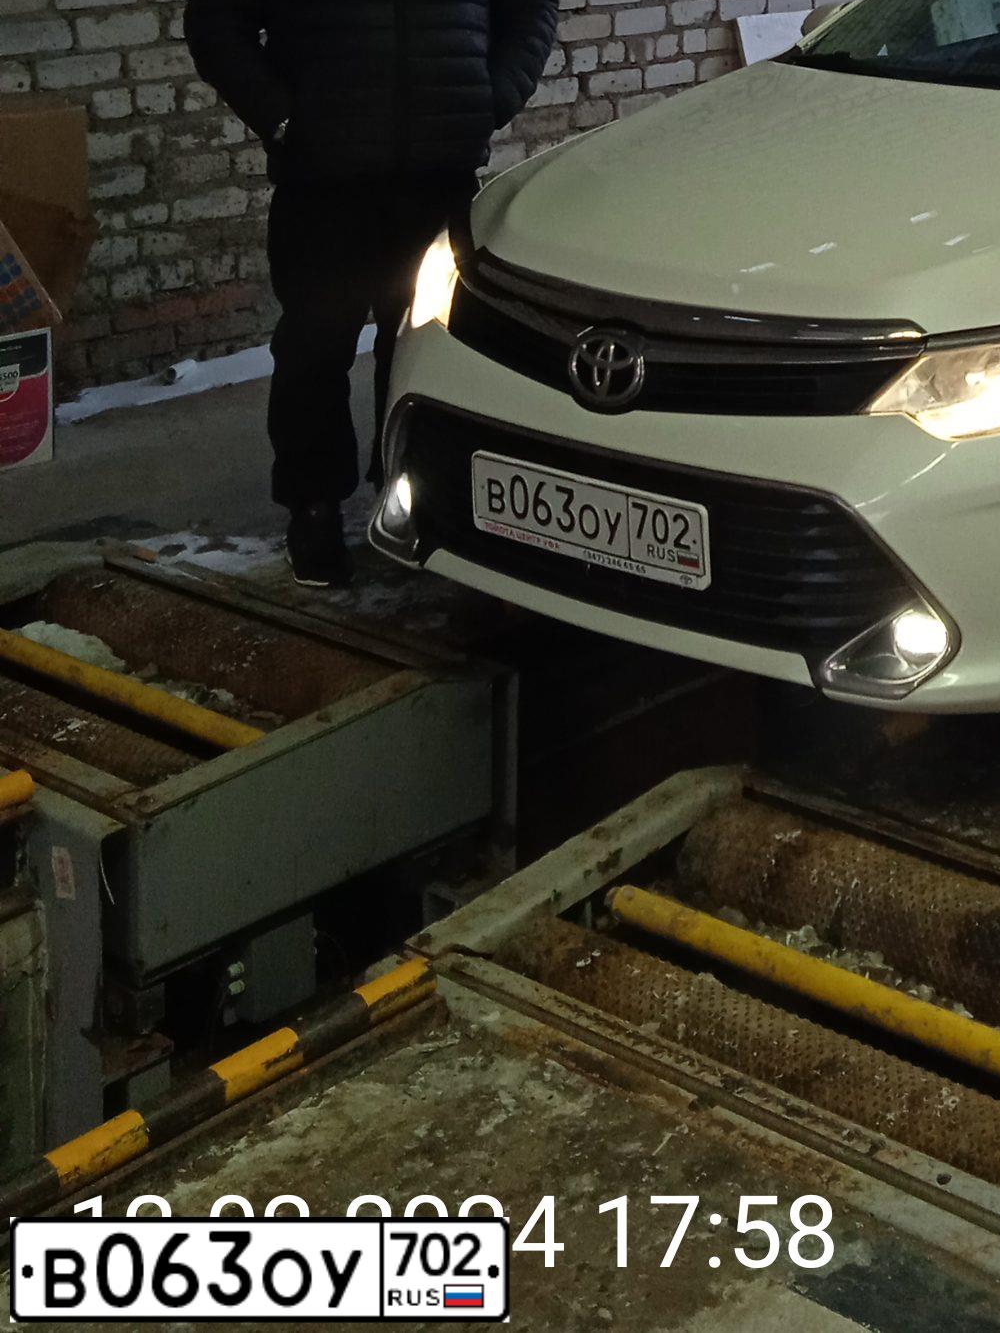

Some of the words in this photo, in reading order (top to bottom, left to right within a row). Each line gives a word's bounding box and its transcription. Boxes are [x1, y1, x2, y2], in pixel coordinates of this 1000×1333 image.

[486, 474, 622, 546] В063ОУ
[631, 501, 691, 551] 702
[646, 544, 676, 563] RUS
